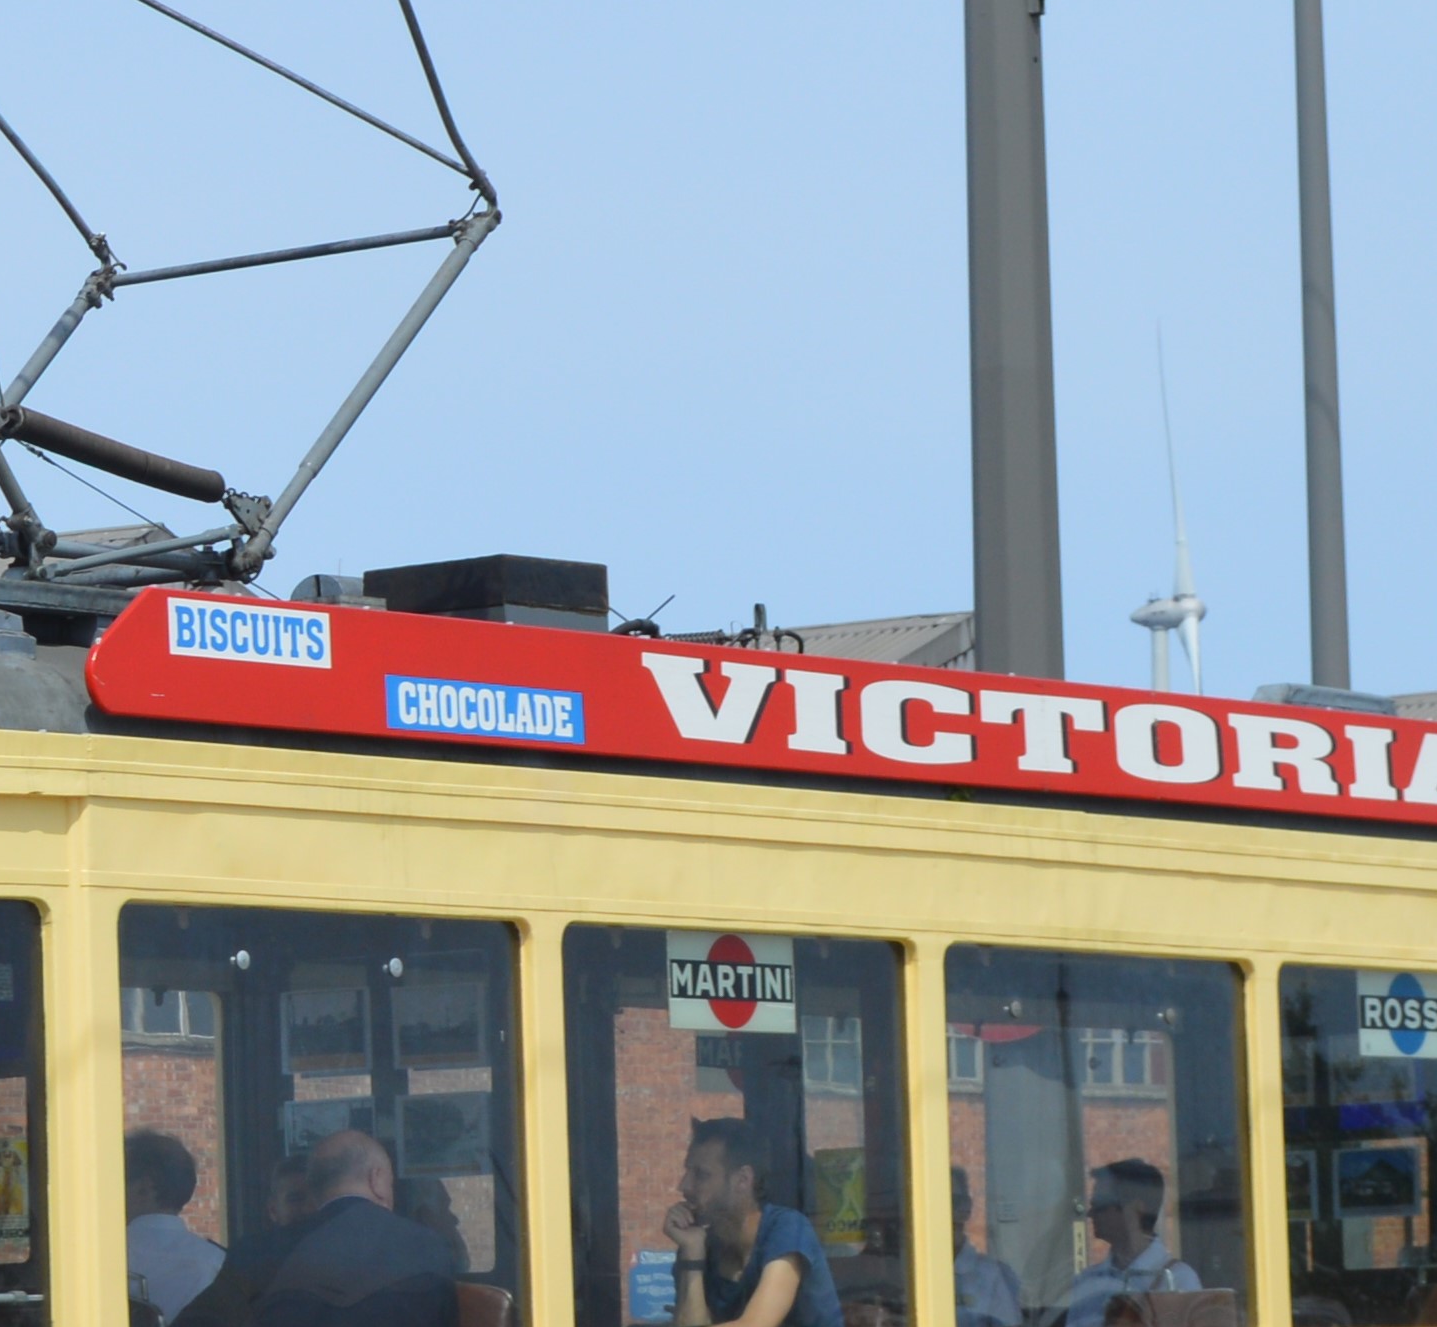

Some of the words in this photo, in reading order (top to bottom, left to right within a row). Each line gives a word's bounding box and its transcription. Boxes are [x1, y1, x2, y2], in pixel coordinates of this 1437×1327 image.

[175, 606, 325, 661] BISCUITS
[398, 681, 574, 738] CHOCOLADE
[671, 963, 792, 1000] MARTINI
